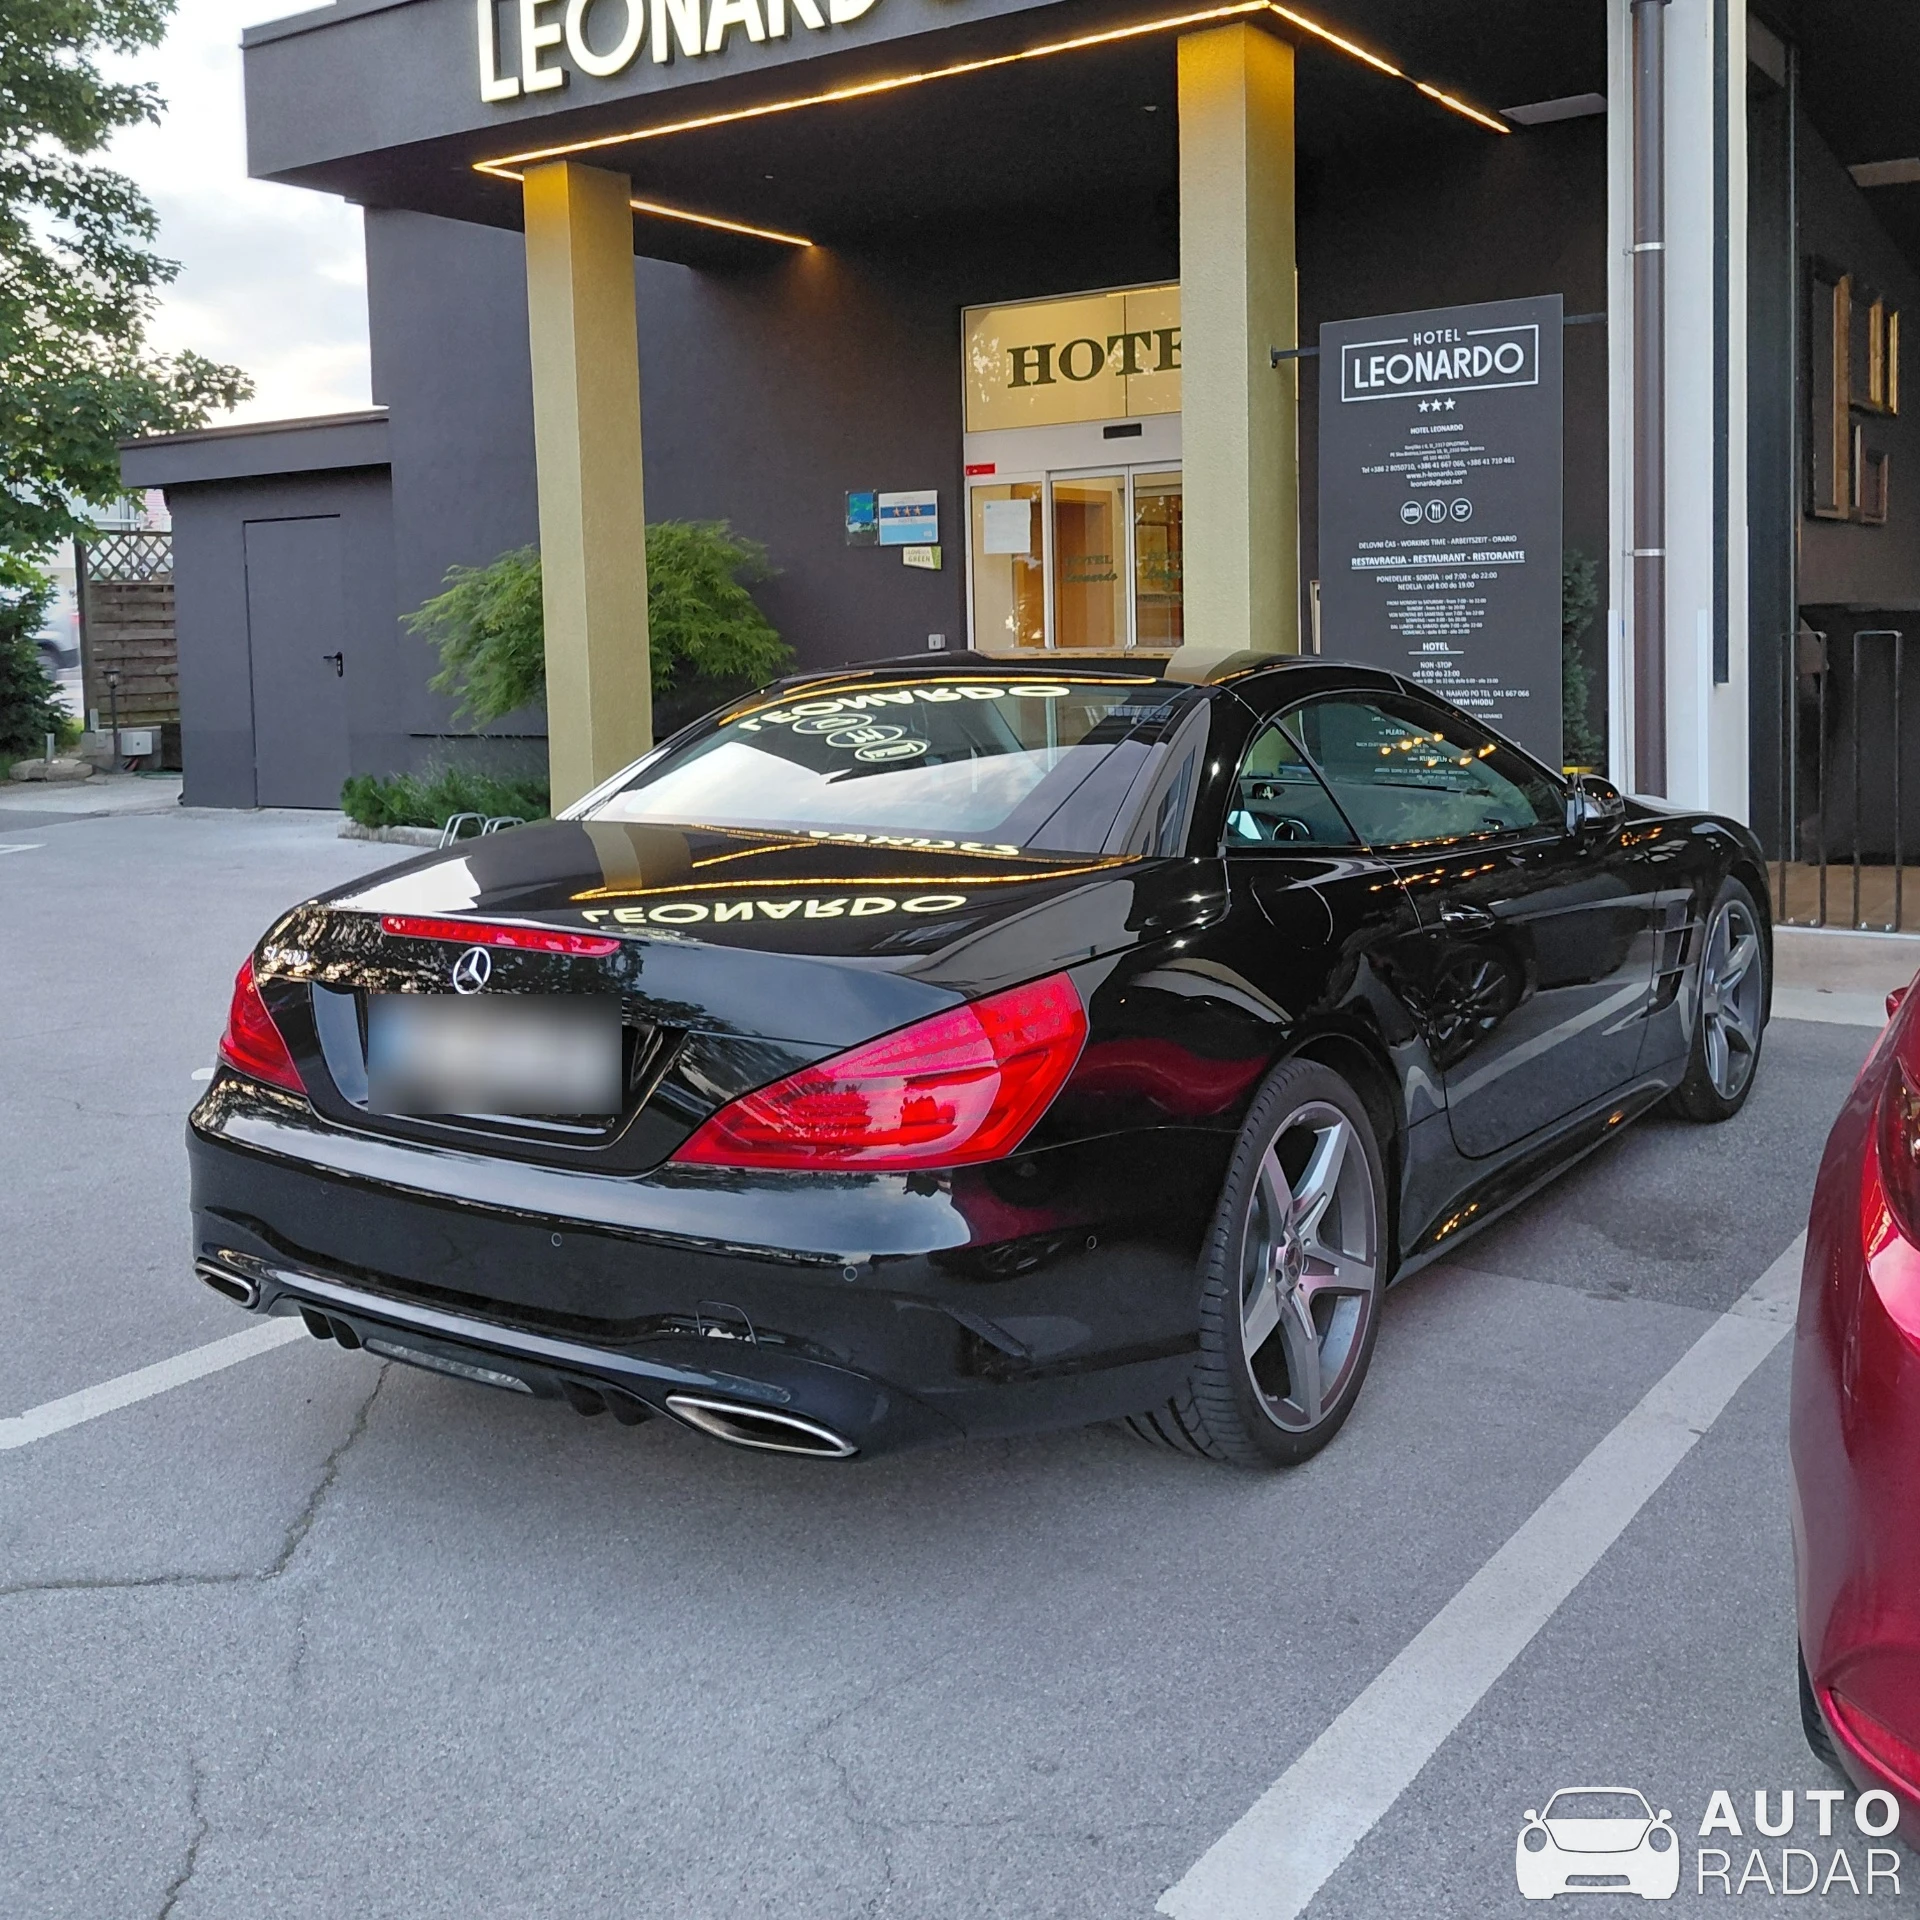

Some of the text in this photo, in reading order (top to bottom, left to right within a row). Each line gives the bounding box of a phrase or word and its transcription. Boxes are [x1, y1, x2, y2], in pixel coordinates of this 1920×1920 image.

[478, 0, 883, 102] LEONA
[1413, 329, 1461, 345] HOTEL
[1354, 342, 1524, 388] LEONARDO
[1410, 424, 1464, 435] HOTEL LEONARDO
[1417, 462, 1432, 470] +386
[1406, 469, 1467, 479] www.h-leonardo.com
[1358, 541, 1384, 549] DELOVNI
[1385, 539, 1397, 548] ČAS
[1400, 539, 1430, 547] WORKING
[1430, 538, 1446, 546] TIME
[1450, 536, 1488, 545] ARBEITSZEIT
[1492, 535, 1517, 543] ORARIO
[1351, 555, 1407, 566] RESTAVRACIJA
[1413, 553, 1467, 563] RESTAURANT
[1472, 550, 1525, 561] RISTORANTE
[1376, 575, 1412, 583] PONEDELJEK
[1416, 573, 1440, 581] SOBOTA
[1454, 572, 1467, 580] 7:00
[1397, 583, 1423, 591] NEDELJA
[1426, 582, 1434, 590] od
[1422, 641, 1449, 651] HOTEL
[1420, 661, 1435, 669] NON
[1412, 670, 1421, 678] od
[1434, 670, 1443, 678] do
[1446, 689, 1470, 697] NAJAVO
[1492, 689, 1505, 697] 041
